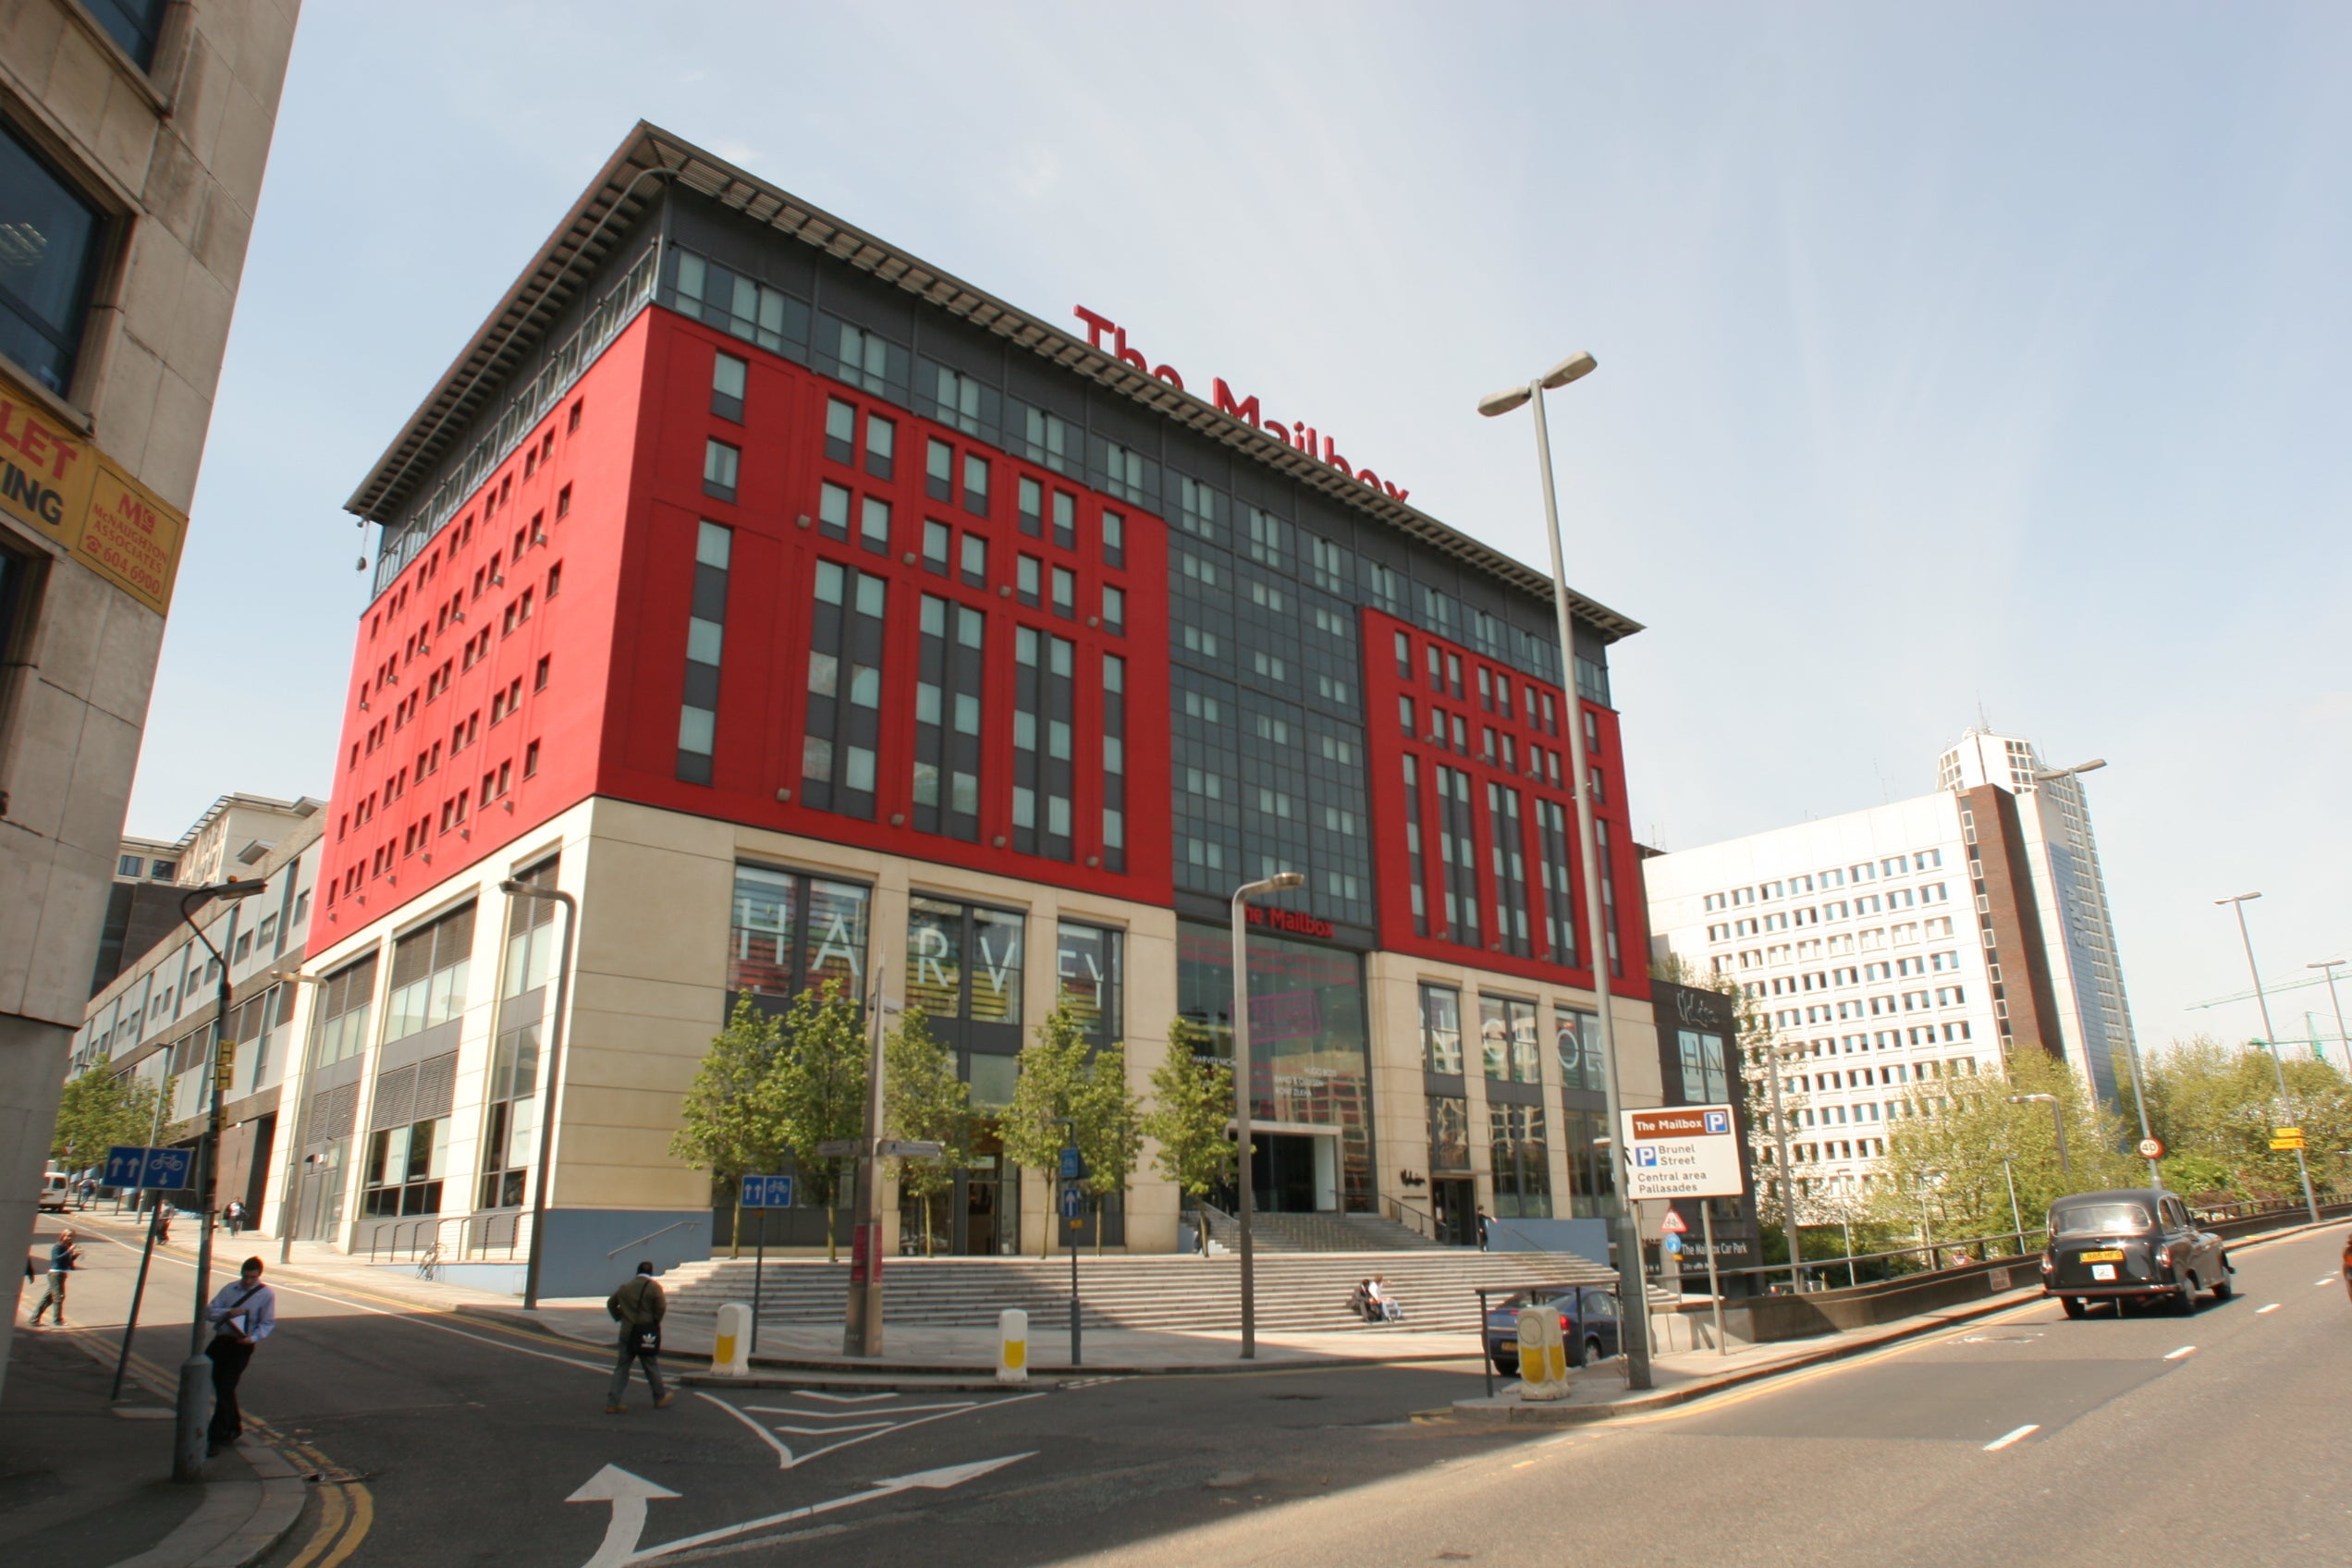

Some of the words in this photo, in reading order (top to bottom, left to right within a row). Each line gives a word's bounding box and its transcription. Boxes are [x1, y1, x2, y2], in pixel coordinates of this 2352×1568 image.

[0, 399, 78, 480] LET
[92, 520, 163, 574] ASSOCIATES
[104, 547, 129, 572] 604
[129, 565, 161, 595] 6900
[1245, 902, 1264, 925] he
[1268, 906, 1336, 938] Mailbox
[1635, 1120, 1656, 1133] The
[1659, 1118, 1703, 1131] Mailbox
[1710, 1114, 1723, 1132] P
[1639, 1147, 1652, 1165] P
[1659, 1144, 1696, 1155] Brunel
[2141, 1143, 2157, 1152] 40
[1660, 1156, 1696, 1166] Street
[1637, 1172, 1679, 1182] Central
[1683, 1171, 1707, 1181] area
[1639, 1183, 1698, 1194] Pallasades
[1682, 1243, 1695, 1256] The
[1721, 1243, 1732, 1255] Car
[1733, 1242, 1747, 1254] Park
